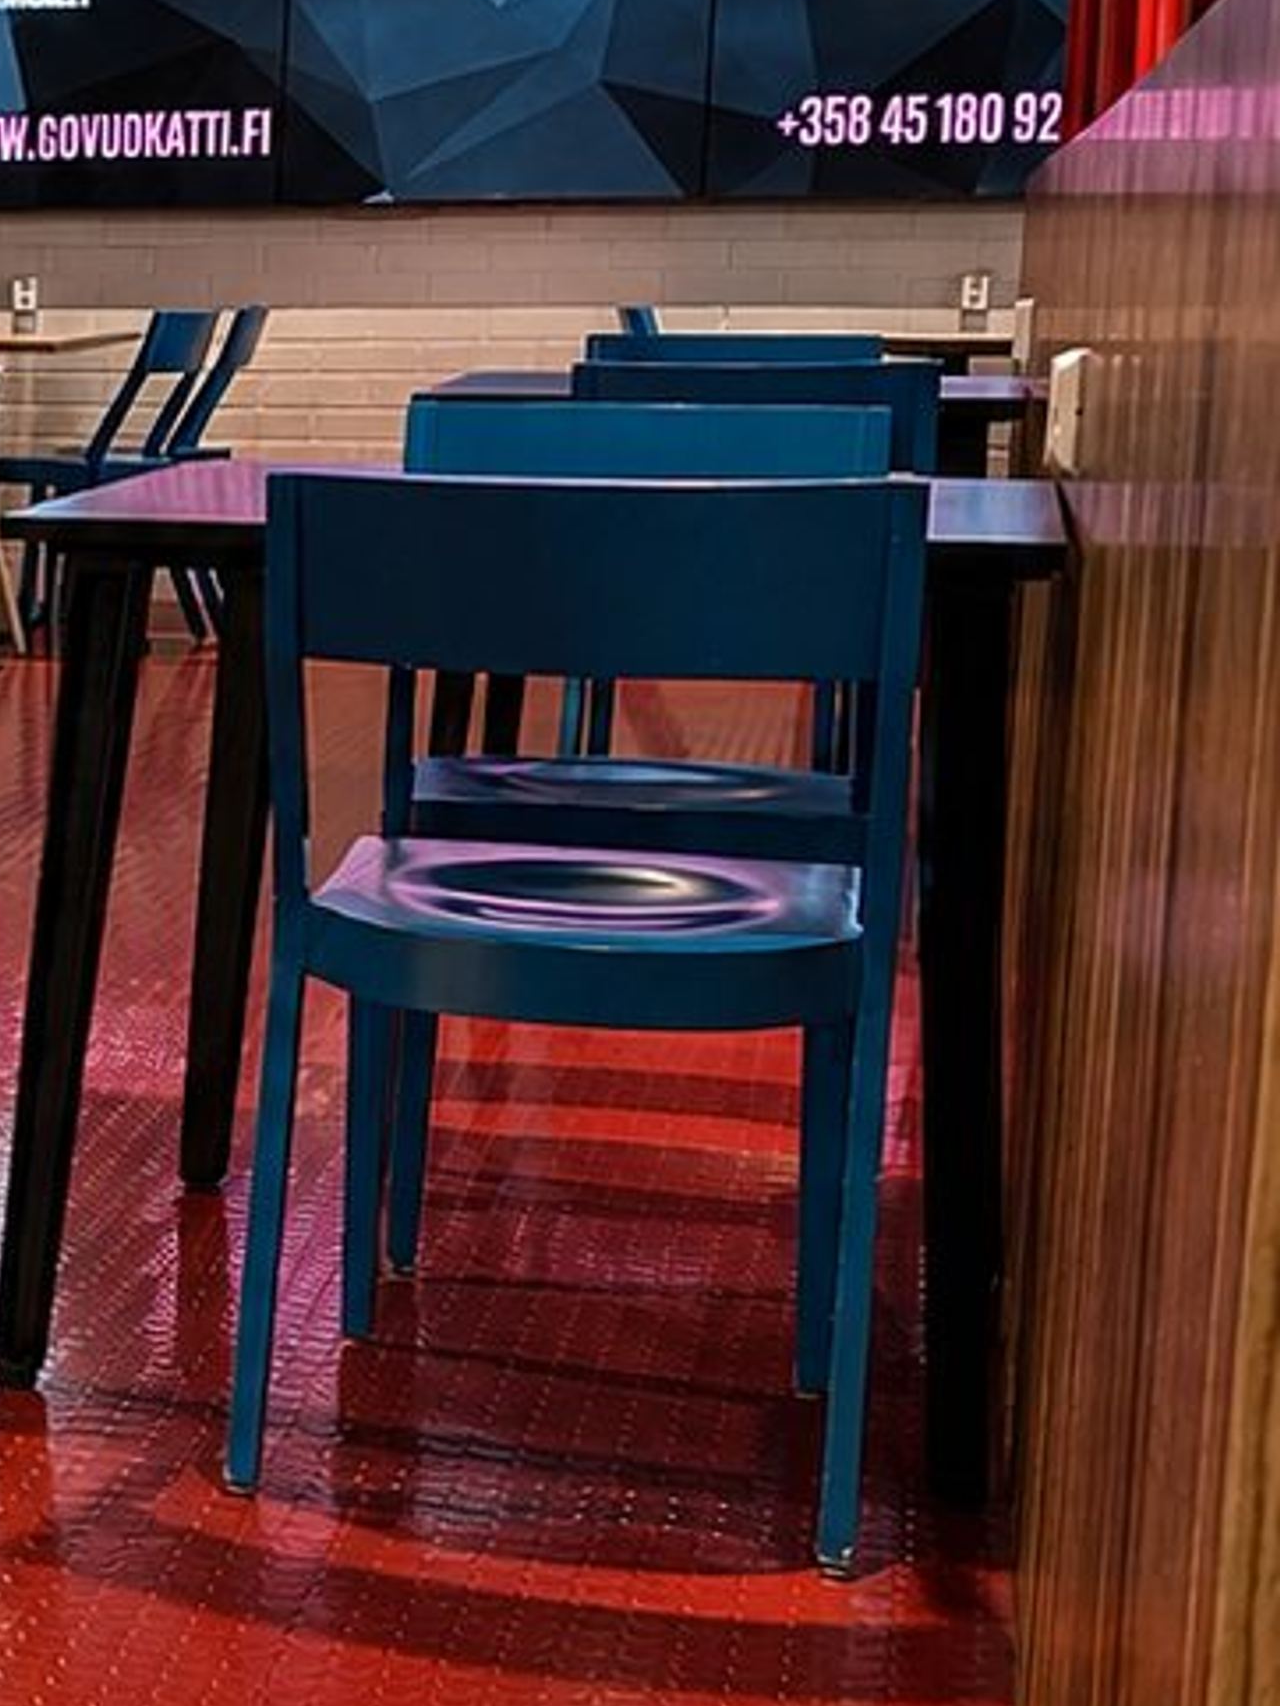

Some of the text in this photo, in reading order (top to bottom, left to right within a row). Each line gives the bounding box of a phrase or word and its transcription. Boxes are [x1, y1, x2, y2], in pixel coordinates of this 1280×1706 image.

[777, 91, 1063, 145] +358 45 180 92
